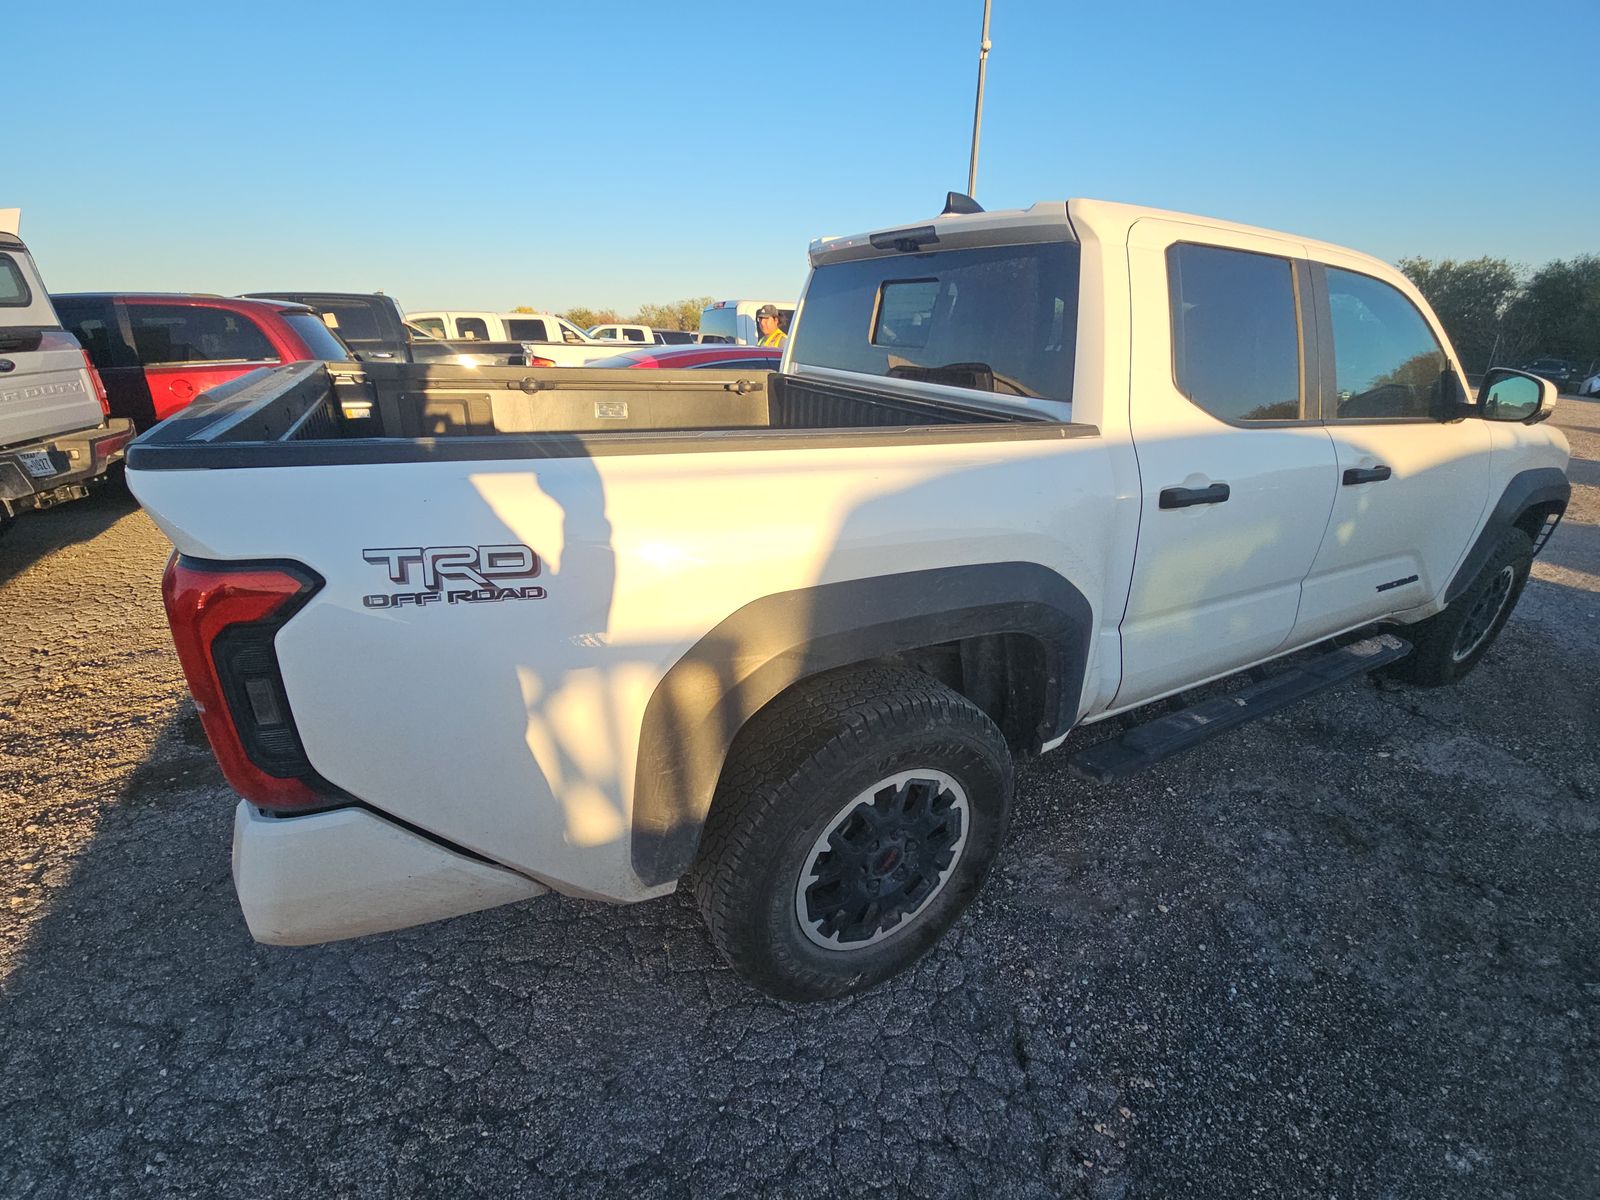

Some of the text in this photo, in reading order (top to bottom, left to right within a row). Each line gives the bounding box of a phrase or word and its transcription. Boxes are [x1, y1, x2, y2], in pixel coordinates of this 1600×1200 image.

[24, 381, 80, 399] DUTY
[363, 544, 541, 591] TRD
[363, 586, 547, 609] OFF ROAD
